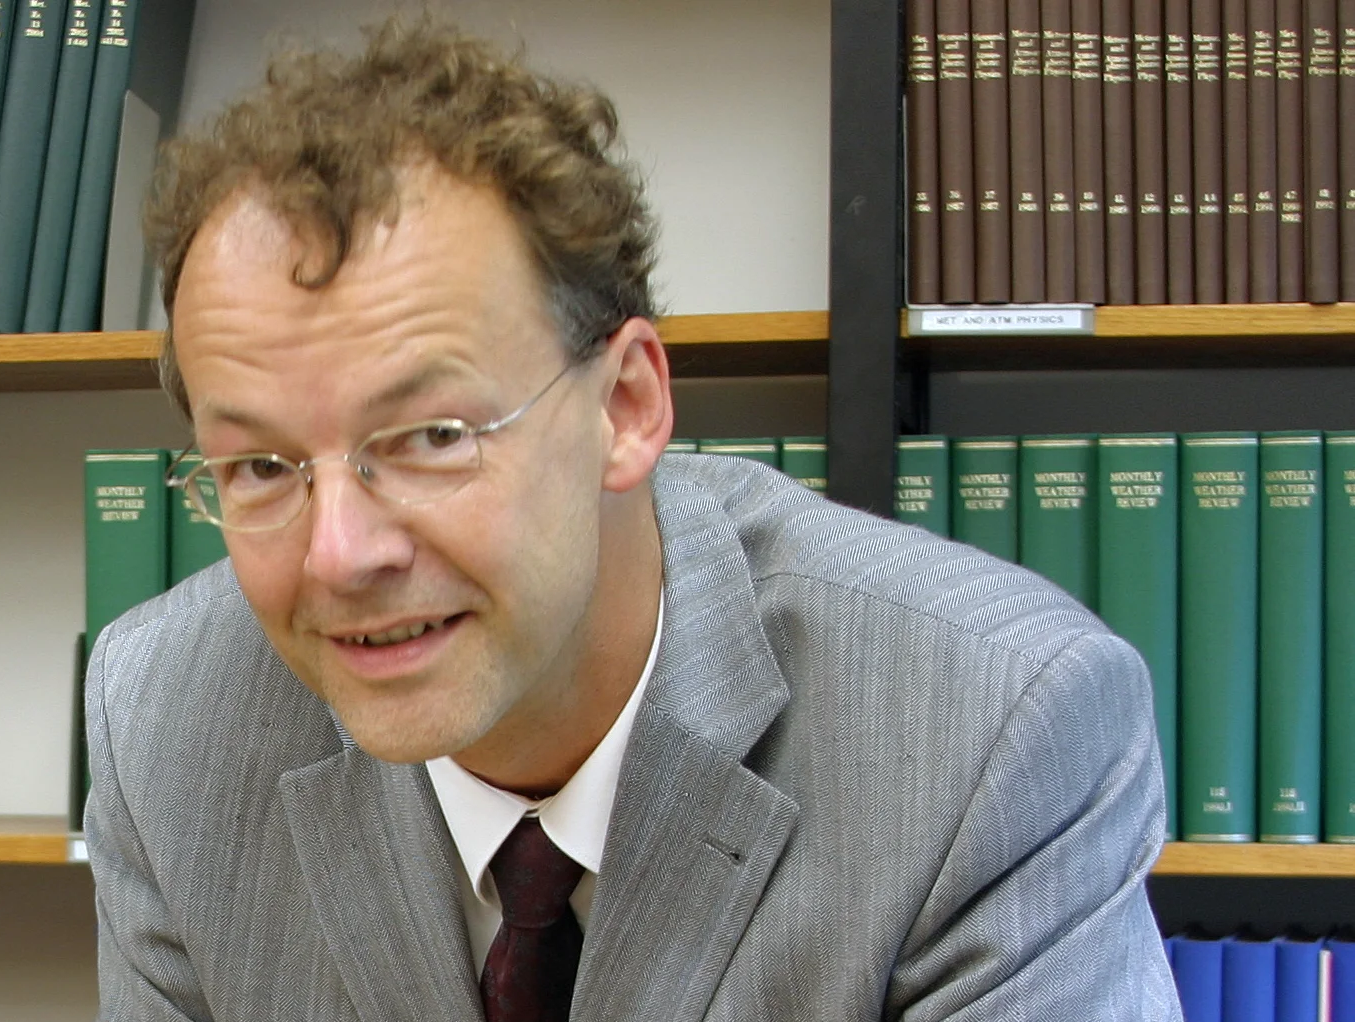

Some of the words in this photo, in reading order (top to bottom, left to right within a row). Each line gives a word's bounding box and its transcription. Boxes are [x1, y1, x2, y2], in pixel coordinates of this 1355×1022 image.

[964, 316, 982, 324] AND
[989, 315, 1011, 324] ATM
[1017, 314, 1064, 324] PHYSICS
[1109, 471, 1163, 482] MONTHLY
[1110, 485, 1163, 496] WEATHER
